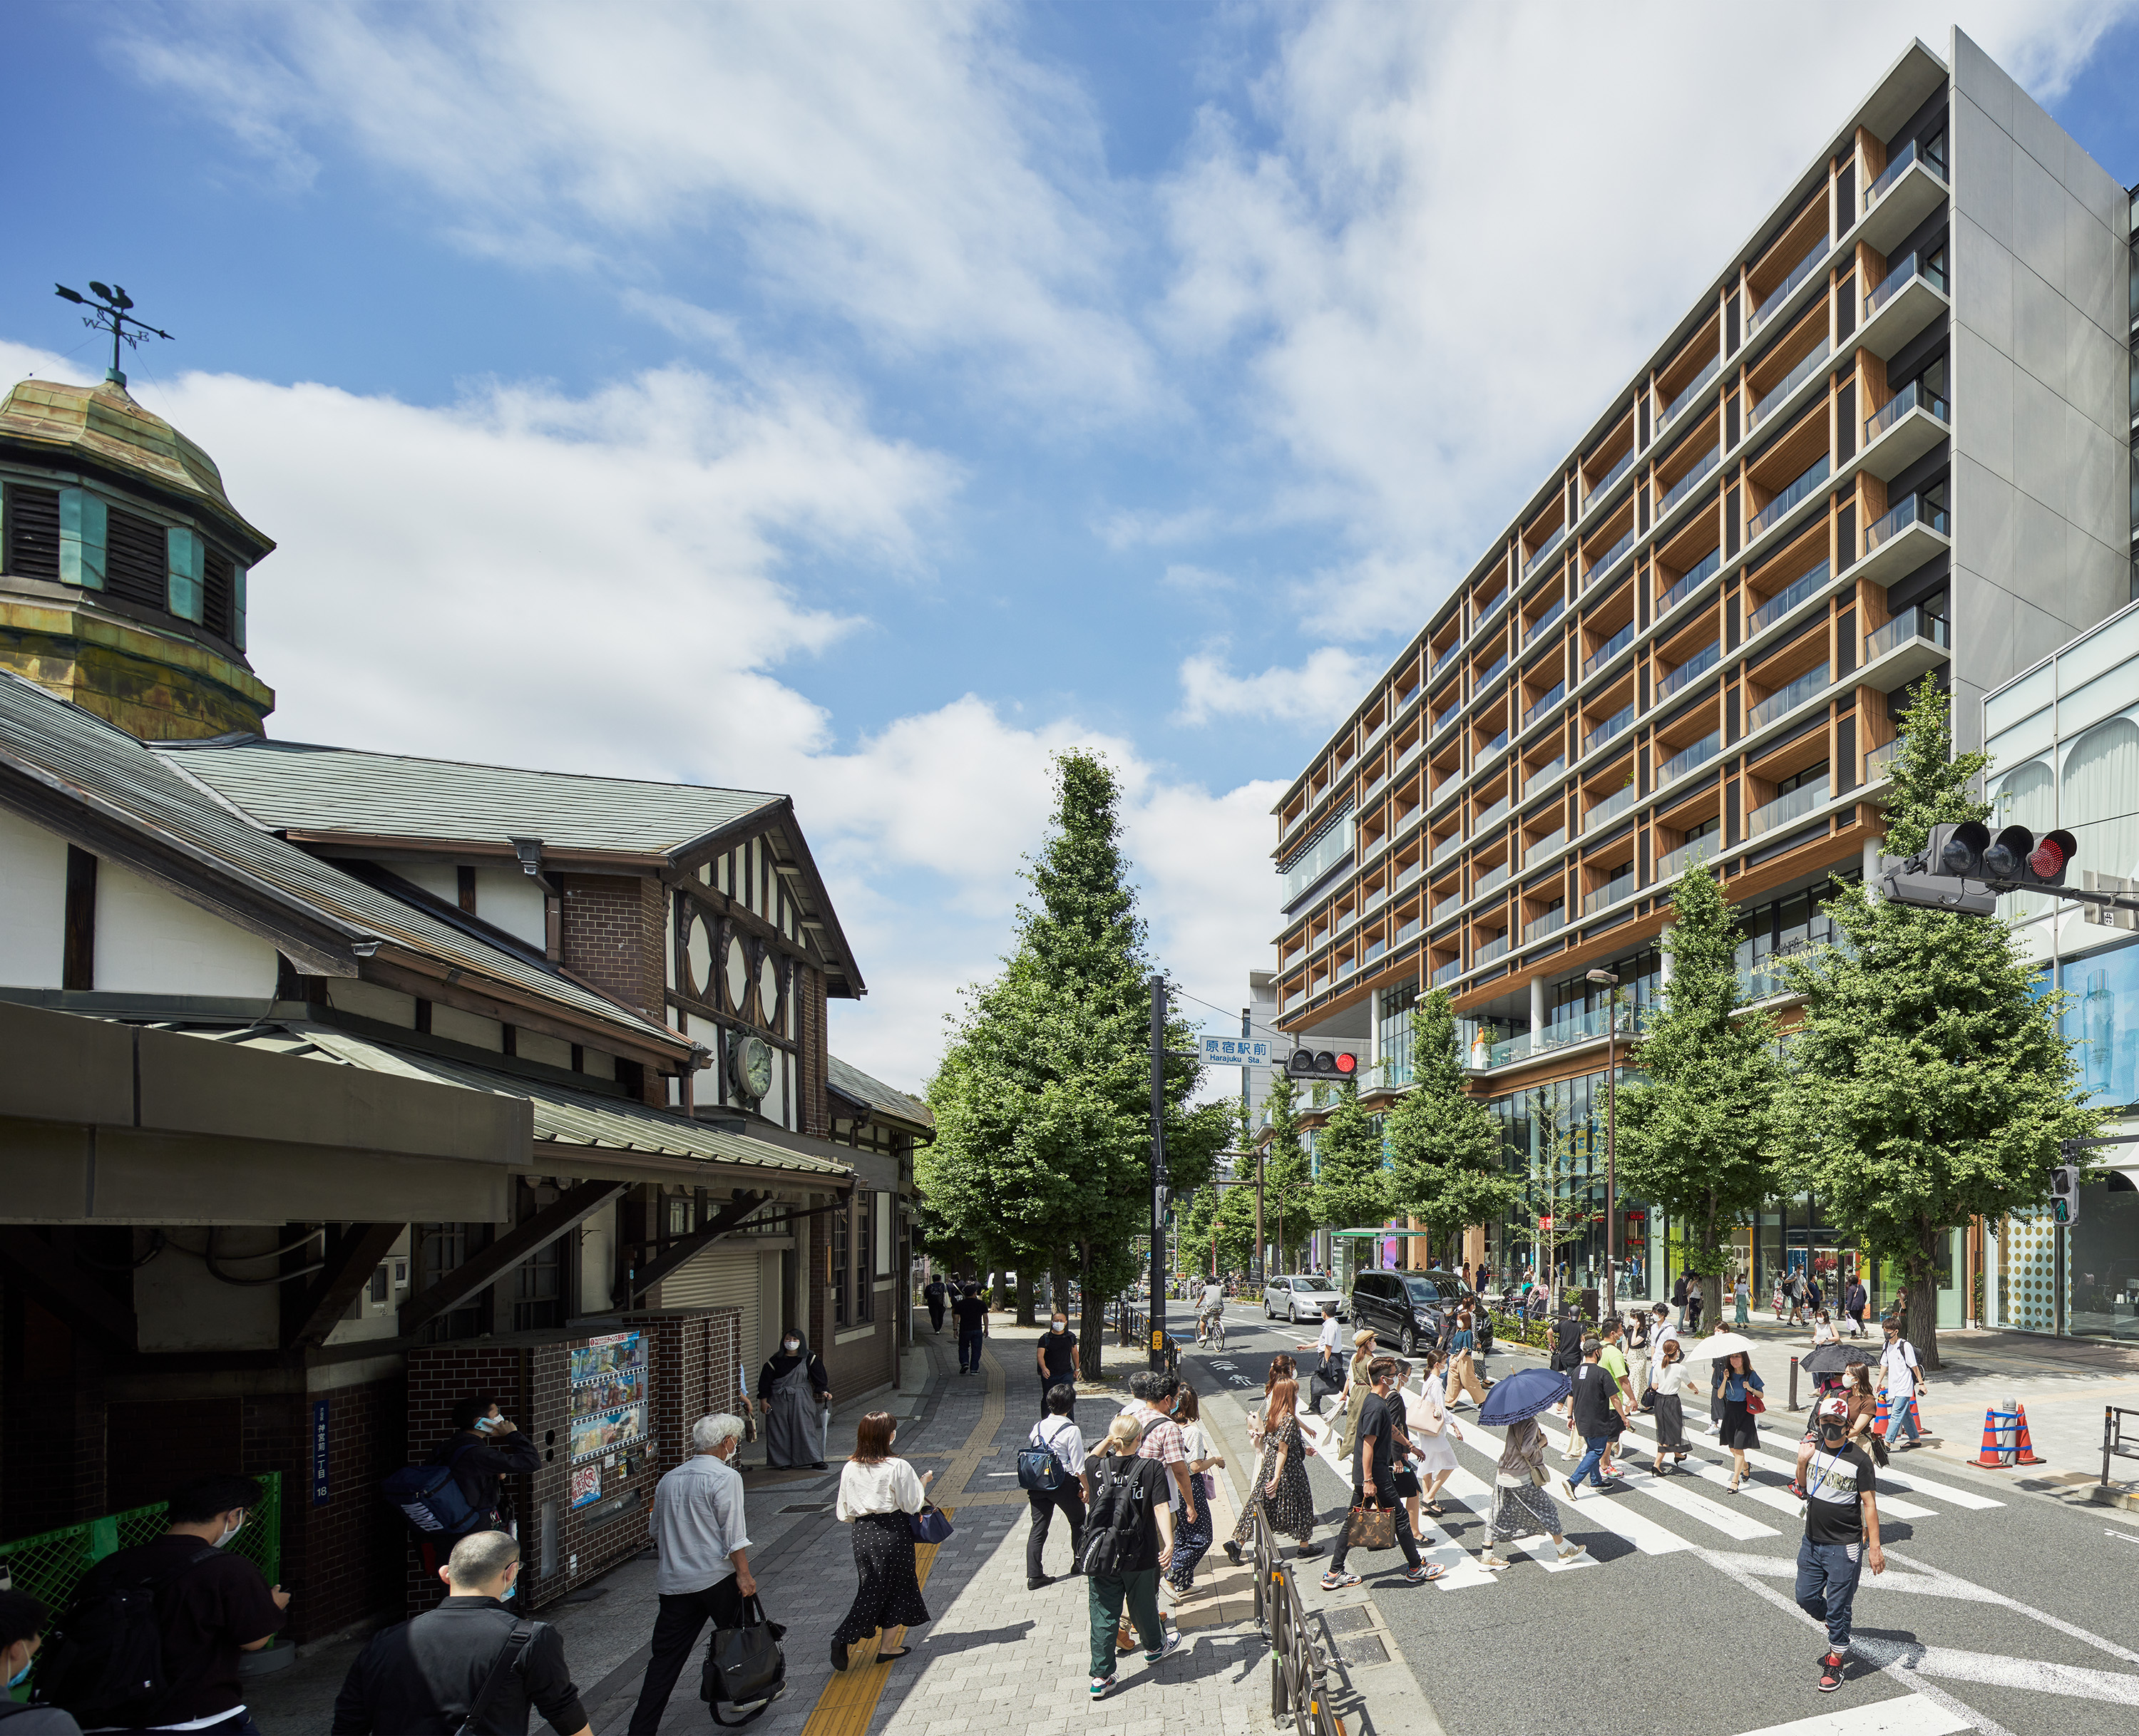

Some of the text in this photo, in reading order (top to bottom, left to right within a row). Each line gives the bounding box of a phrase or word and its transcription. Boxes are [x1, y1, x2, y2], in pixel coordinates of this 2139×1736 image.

[81, 317, 101, 329] W
[137, 330, 149, 342] E
[1750, 963, 1765, 976] AUX
[1205, 1039, 1266, 1056] 原宿駅前
[1209, 1054, 1262, 1064] Harajuku Sta.
[317, 1424, 326, 1479] 神宮前一丁目
[317, 1486, 327, 1496] 18
[401, 1502, 444, 1532] MARVEL
